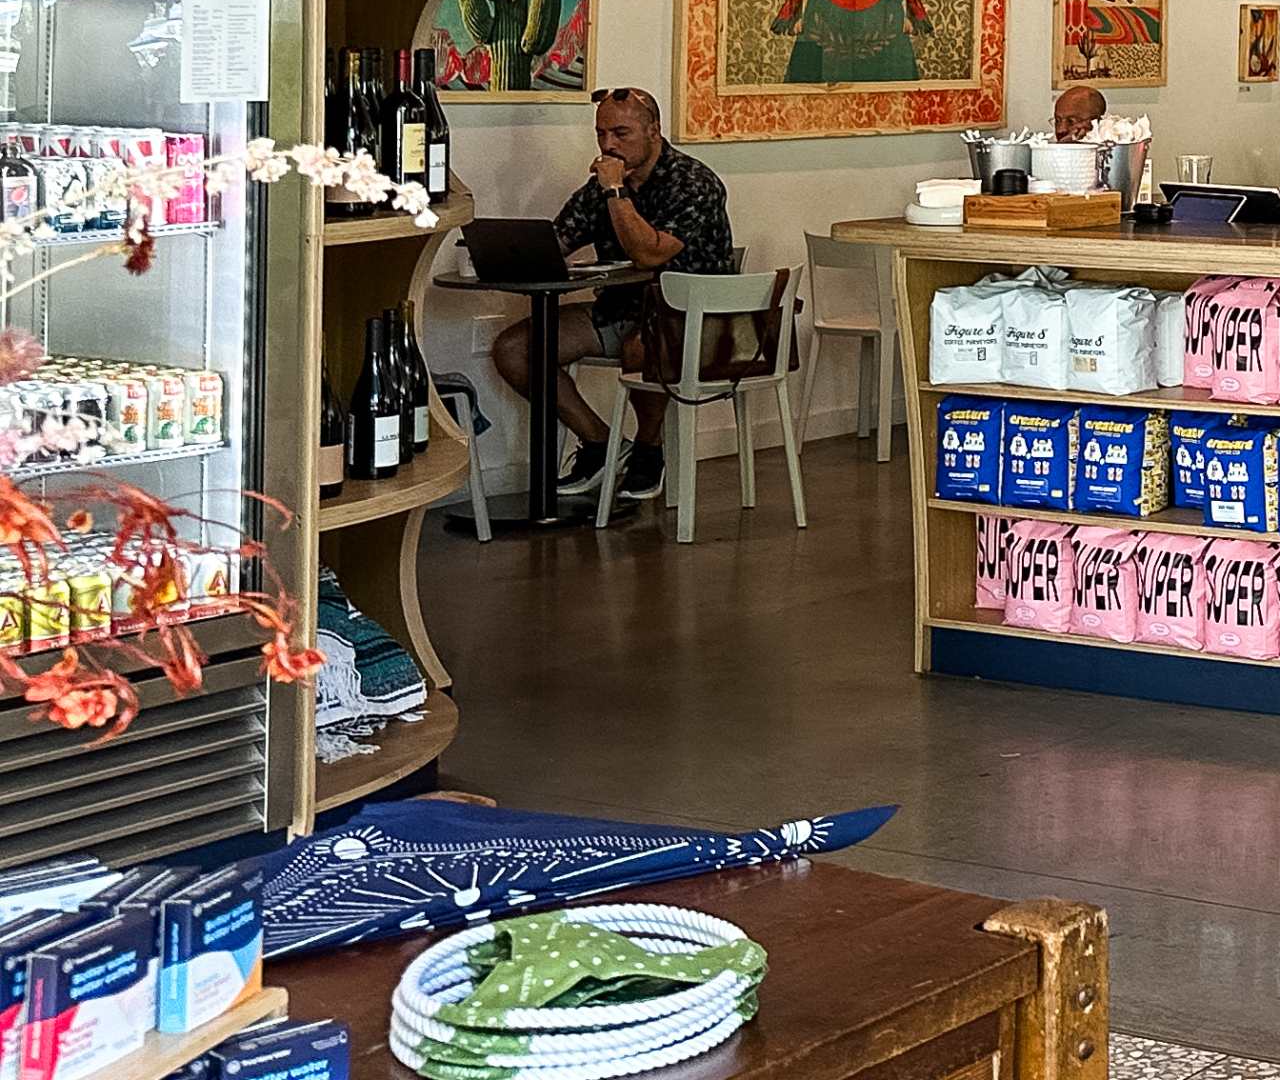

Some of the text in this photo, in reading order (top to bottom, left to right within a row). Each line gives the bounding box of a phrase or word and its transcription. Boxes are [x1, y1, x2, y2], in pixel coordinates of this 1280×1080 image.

[944, 324, 984, 339] Figure
[1006, 327, 1035, 340] Figure
[1210, 303, 1263, 372] SUPER
[1084, 421, 1134, 434] creature
[1205, 555, 1264, 626] SUPER
